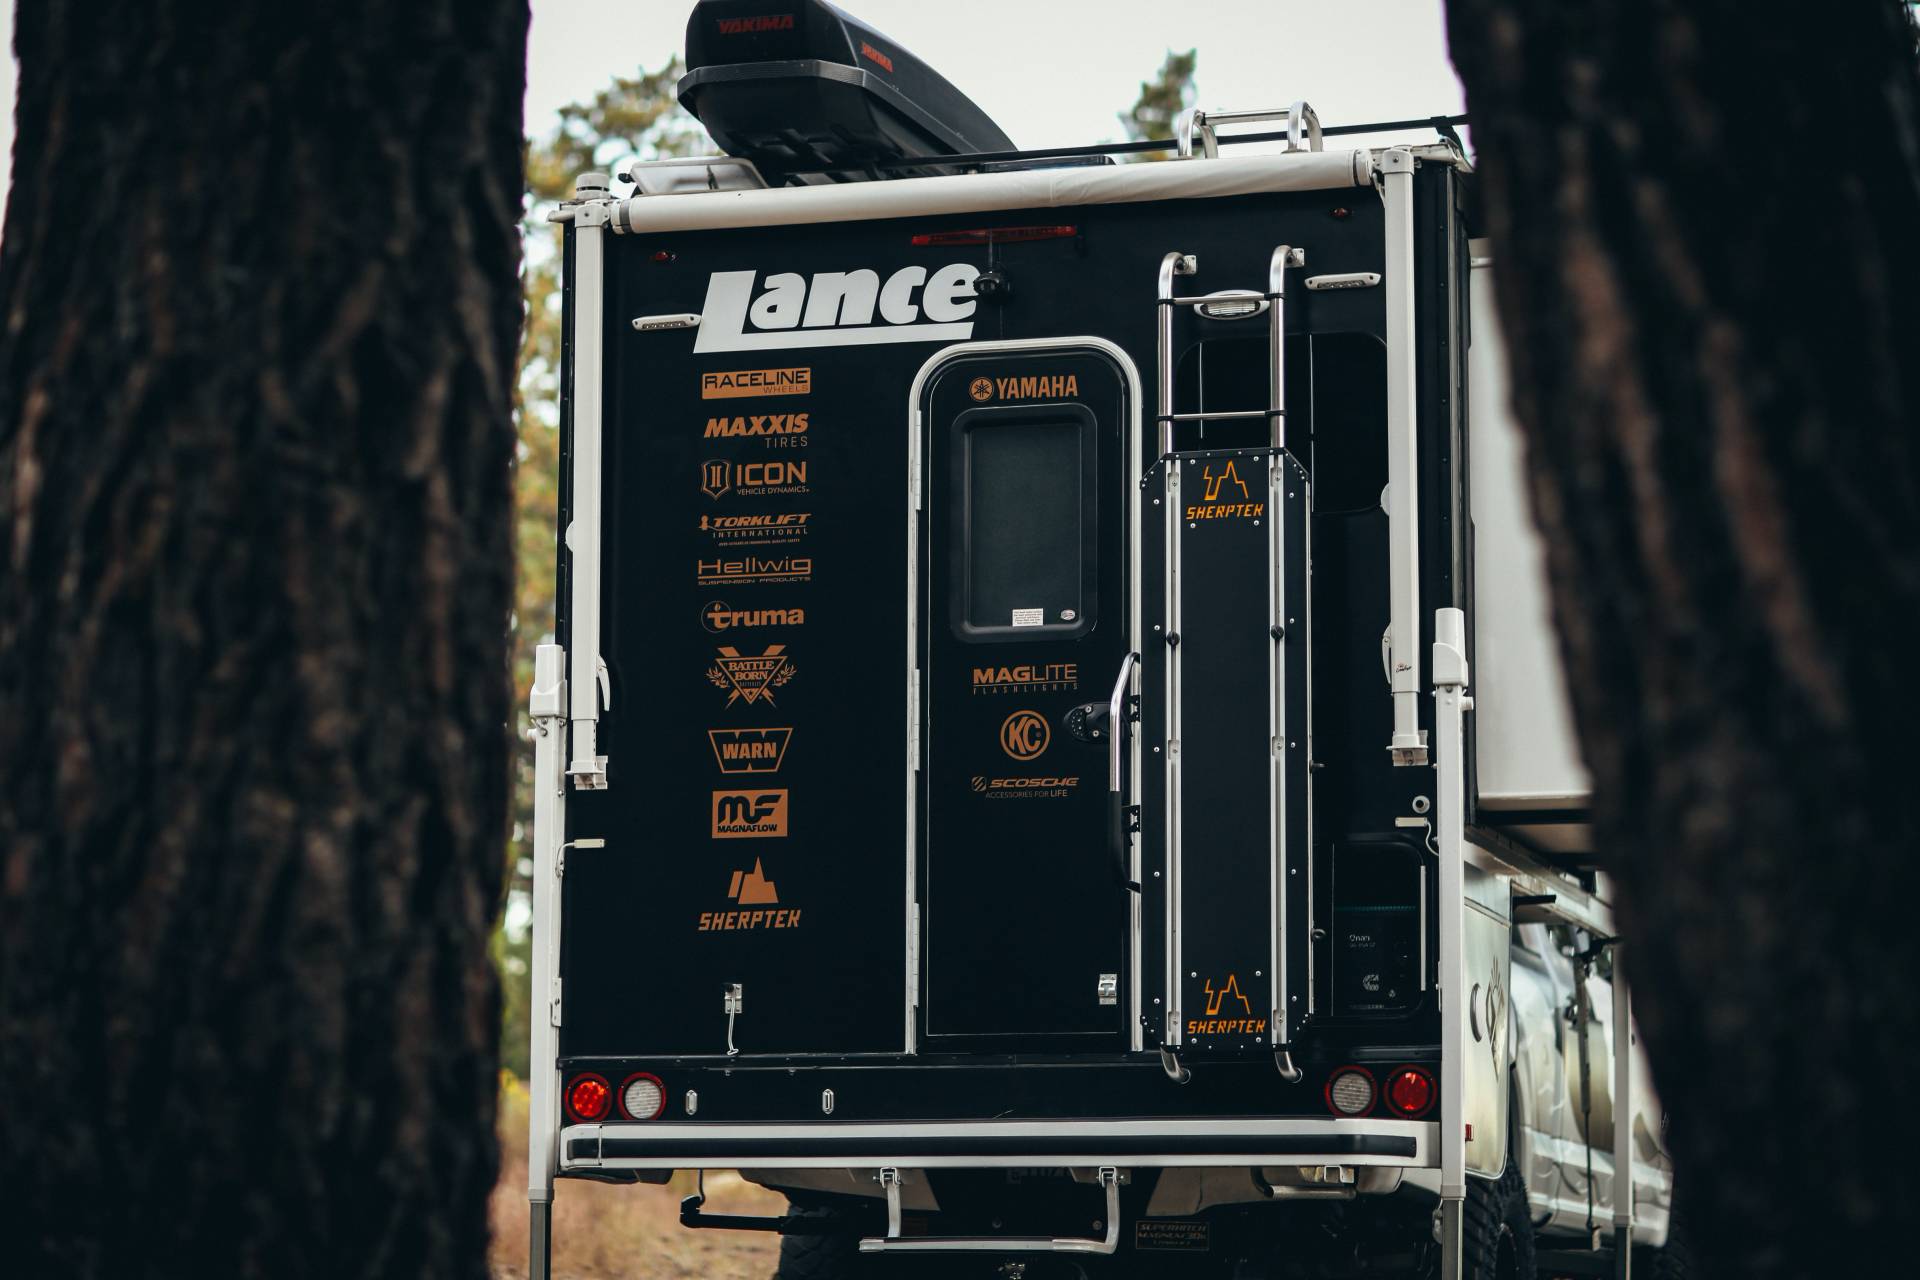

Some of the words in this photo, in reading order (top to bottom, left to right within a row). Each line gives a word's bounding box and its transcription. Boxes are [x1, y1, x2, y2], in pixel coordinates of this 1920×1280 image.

[719, 15, 794, 34] YAKIMA
[862, 42, 894, 73] YAKIMA
[693, 263, 982, 354] Lance
[704, 370, 808, 389] RACELINE
[995, 375, 1078, 400] YAMAHA
[763, 384, 808, 394] WHEELS
[704, 413, 809, 438] MAXXIS
[765, 436, 808, 449] TIRES
[736, 461, 807, 487] ICON
[737, 487, 765, 496] VEHICLE
[1186, 504, 1264, 520] SHERPTEK
[713, 513, 812, 528] TORKLIFT
[713, 528, 808, 539] INTERNATIONAL
[698, 556, 812, 578] Hellwig
[698, 578, 756, 586] SUSPENSION
[707, 608, 805, 630] truma
[728, 660, 775, 671] BATTLE
[735, 671, 769, 681] BORN
[973, 664, 1078, 684] MAGLITE
[973, 683, 1078, 695] FLASHLIGHTS
[1008, 716, 1041, 755] KC
[722, 742, 777, 760] WARN
[990, 777, 1080, 788] SCOSCHE
[985, 790, 1033, 799] ACCESSORIES
[1034, 790, 1050, 798] FOR
[1050, 789, 1068, 797] LIFE
[717, 824, 778, 834] MAGNAFLOW
[698, 908, 802, 931] SHERPTEK
[1187, 1019, 1266, 1034] SHERPTEK
